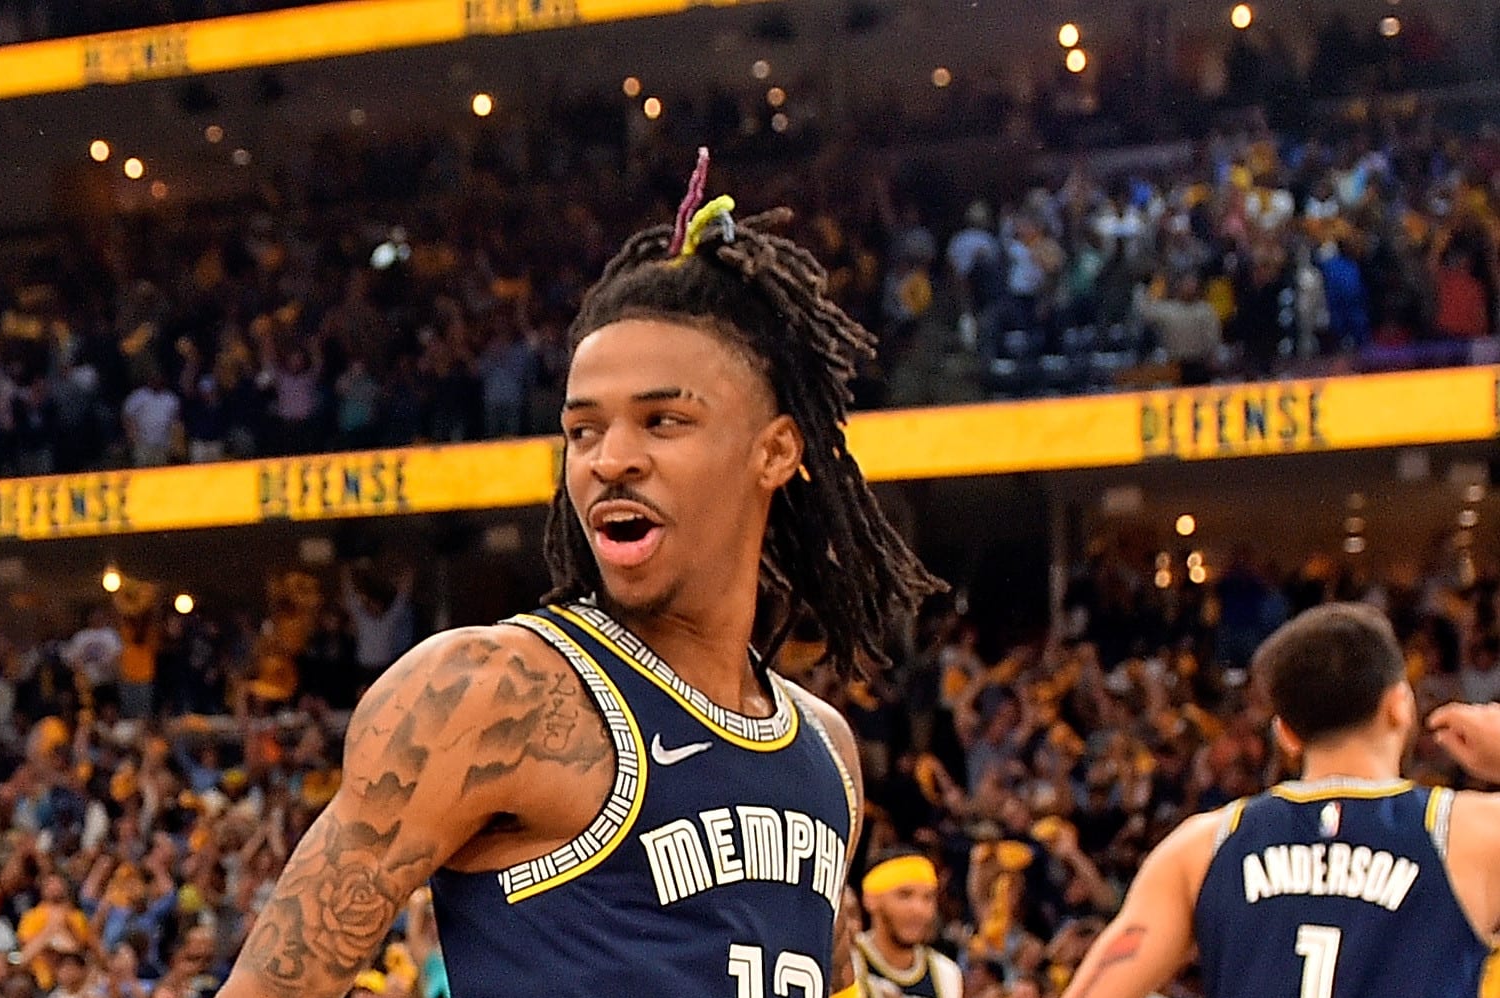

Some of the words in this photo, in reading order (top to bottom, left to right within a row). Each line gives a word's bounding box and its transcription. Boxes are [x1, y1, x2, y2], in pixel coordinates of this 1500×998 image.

[1141, 388, 1323, 443] DEFENSE
[260, 456, 409, 506] DEFENSE
[1243, 843, 1420, 912] ANDERSON
